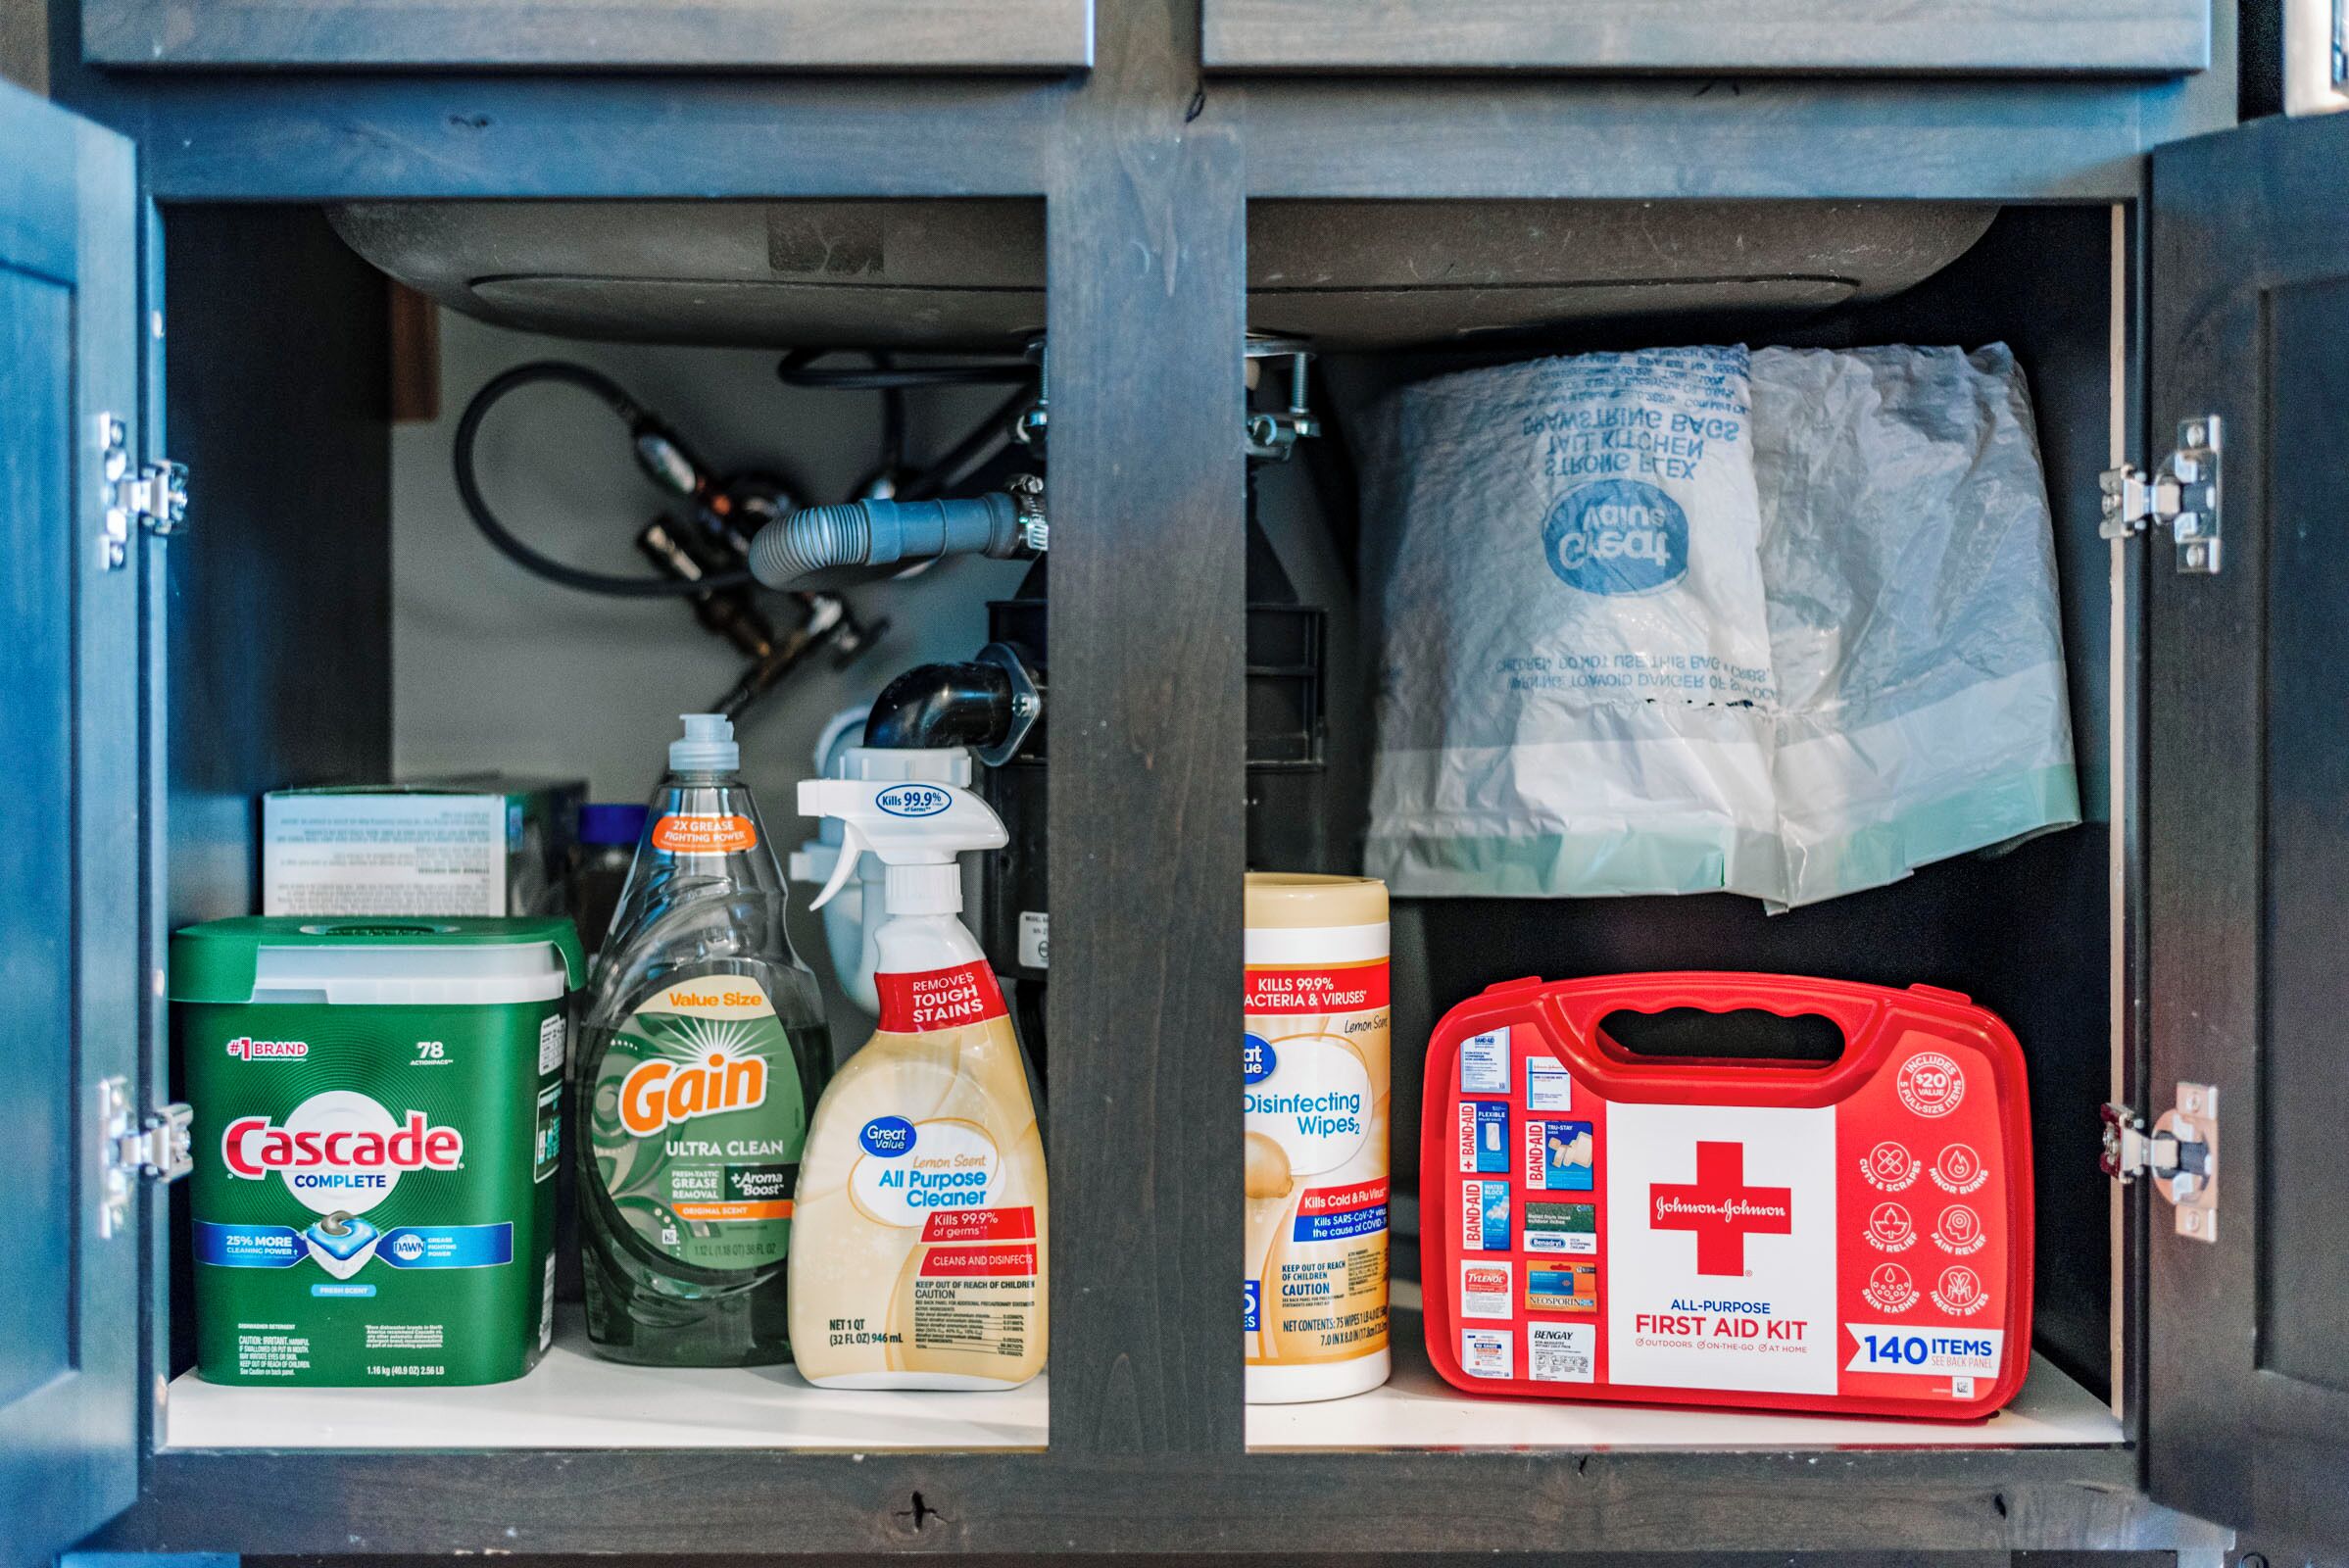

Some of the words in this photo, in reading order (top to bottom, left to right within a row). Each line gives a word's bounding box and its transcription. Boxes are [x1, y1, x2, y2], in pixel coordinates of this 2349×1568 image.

[882, 796, 903, 807] Kills
[904, 791, 942, 807] 99.9%
[672, 820, 688, 832] 2X
[690, 820, 735, 832] GREASE
[664, 831, 710, 843] FIGHTING
[712, 831, 746, 843] POWER
[912, 972, 974, 992] REMOVES
[1257, 978, 1293, 992] KILLS
[1296, 976, 1334, 992] 99.9%
[669, 992, 719, 1007] Value
[723, 992, 762, 1007] Size
[912, 984, 978, 1007] TOUGH
[1245, 993, 1305, 1007] ACTERIA
[1308, 993, 1318, 1006] &
[912, 998, 984, 1023] STAINS
[1345, 1019, 1372, 1034] Lemon
[226, 1037, 252, 1060] #1
[253, 1042, 308, 1056] BRAND
[416, 1041, 445, 1059] 78
[1245, 1045, 1262, 1062] at
[1245, 1062, 1262, 1074] ue
[1905, 1054, 1957, 1076] INCLUDES
[1915, 1072, 1947, 1089] $20
[619, 1053, 766, 1136] Gain
[1902, 1089, 1946, 1113] FULL-SIZE
[1943, 1079, 1962, 1111] ITEMS
[1918, 1088, 1945, 1097] VALUE
[1245, 1092, 1361, 1114] Disinfecting
[866, 1124, 907, 1142] Great
[1461, 1105, 1475, 1154] BAND-AID
[223, 1111, 462, 1179] Cascade
[665, 1140, 722, 1156] ULTRA
[726, 1139, 784, 1155] CLEAN
[875, 1138, 905, 1151] Value
[1529, 1124, 1543, 1181] BAND-AID
[912, 1155, 951, 1170] Lemon
[954, 1153, 987, 1167] Scent
[294, 1174, 386, 1188] COMPLETE
[671, 1178, 718, 1189] GREASE
[878, 1169, 904, 1188] All
[908, 1169, 987, 1192] Purpose
[1859, 1158, 1876, 1186] CUTS
[1876, 1181, 1884, 1191] &
[1885, 1159, 1922, 1193] SCRAPES
[1928, 1167, 1958, 1195] MINOR
[1958, 1169, 1989, 1195] BURNS
[672, 1190, 718, 1200] REMOVAL
[905, 1189, 987, 1208] Cleaner
[1304, 1197, 1326, 1208] Kills
[1328, 1193, 1351, 1207] Cold
[1352, 1192, 1358, 1203] &
[1359, 1190, 1368, 1202] Flu
[722, 1206, 748, 1215] SCENT
[934, 1213, 958, 1226] Kills
[961, 1211, 999, 1225] 99.9%
[1465, 1184, 1481, 1241] BAND-AID
[1314, 1216, 1331, 1227] Kills
[933, 1228, 944, 1238] of
[1313, 1228, 1327, 1238] the
[1330, 1225, 1353, 1236] cause
[1354, 1223, 1361, 1233] of
[225, 1235, 253, 1246] 25%
[255, 1236, 293, 1248] MORE
[394, 1241, 425, 1254] DAWN
[1533, 1239, 1562, 1249] Benadryl
[1862, 1230, 1884, 1251] ITCH
[1885, 1231, 1918, 1253] RELIEF
[1930, 1232, 1953, 1253] PAIN
[1955, 1234, 1987, 1255] RELIEF
[933, 1255, 966, 1266] CLEANS
[968, 1255, 988, 1266] AND
[989, 1253, 1033, 1265] DISINFECTS
[1301, 1263, 1315, 1272] OUT
[1327, 1260, 1346, 1270] REACH
[915, 1280, 934, 1289] KEEP
[935, 1280, 950, 1289] OUT
[952, 1280, 962, 1289] OF
[964, 1280, 988, 1289] REACH
[990, 1280, 1000, 1289] OF
[1468, 1273, 1505, 1284] TYLENOL
[915, 1289, 955, 1298] CAUTION
[1282, 1283, 1330, 1296] CAUTION
[1245, 1284, 1255, 1314] 5
[1529, 1296, 1581, 1306] NEOSPORIN
[1670, 1298, 1771, 1314] ALL-PURPOSE
[1861, 1288, 1883, 1310] SKIN
[1883, 1290, 1921, 1314] RASHES
[1930, 1290, 1962, 1316] INSECT
[1963, 1293, 1989, 1316] BITES
[829, 1319, 846, 1331] NET
[847, 1319, 852, 1331] 1
[854, 1318, 865, 1330] QT
[1283, 1319, 1297, 1333] NET
[1298, 1318, 1336, 1332] CONTENTS:
[1337, 1317, 1344, 1328] 75
[1344, 1313, 1360, 1327] WIPES
[1636, 1313, 1706, 1336] FIRST
[1712, 1317, 1759, 1338] AID
[1767, 1320, 1808, 1341] KIT
[830, 1334, 844, 1347] (32
[845, 1334, 855, 1345] FL
[856, 1333, 870, 1346] OZ)
[871, 1333, 888, 1344] 946
[889, 1333, 904, 1344] mL
[1321, 1334, 1332, 1346] 7.0
[1332, 1333, 1340, 1345] IN
[1534, 1330, 1574, 1341] BENGAY
[1645, 1340, 1693, 1348] OUTDOORS
[1706, 1342, 1754, 1350] ON-THE-GO
[1864, 1335, 1928, 1365] 140
[1932, 1338, 1992, 1356] ITEMS
[1932, 1356, 1944, 1366] SEE
[1946, 1357, 1967, 1368] BACK
[1968, 1358, 1992, 1369] PANEL
[367, 1365, 381, 1376] 1.16
[381, 1365, 390, 1377] kg
[391, 1365, 409, 1377] (40.9
[409, 1365, 419, 1376] OZ)
[420, 1365, 435, 1376] 2.56
[435, 1365, 445, 1376] LB
